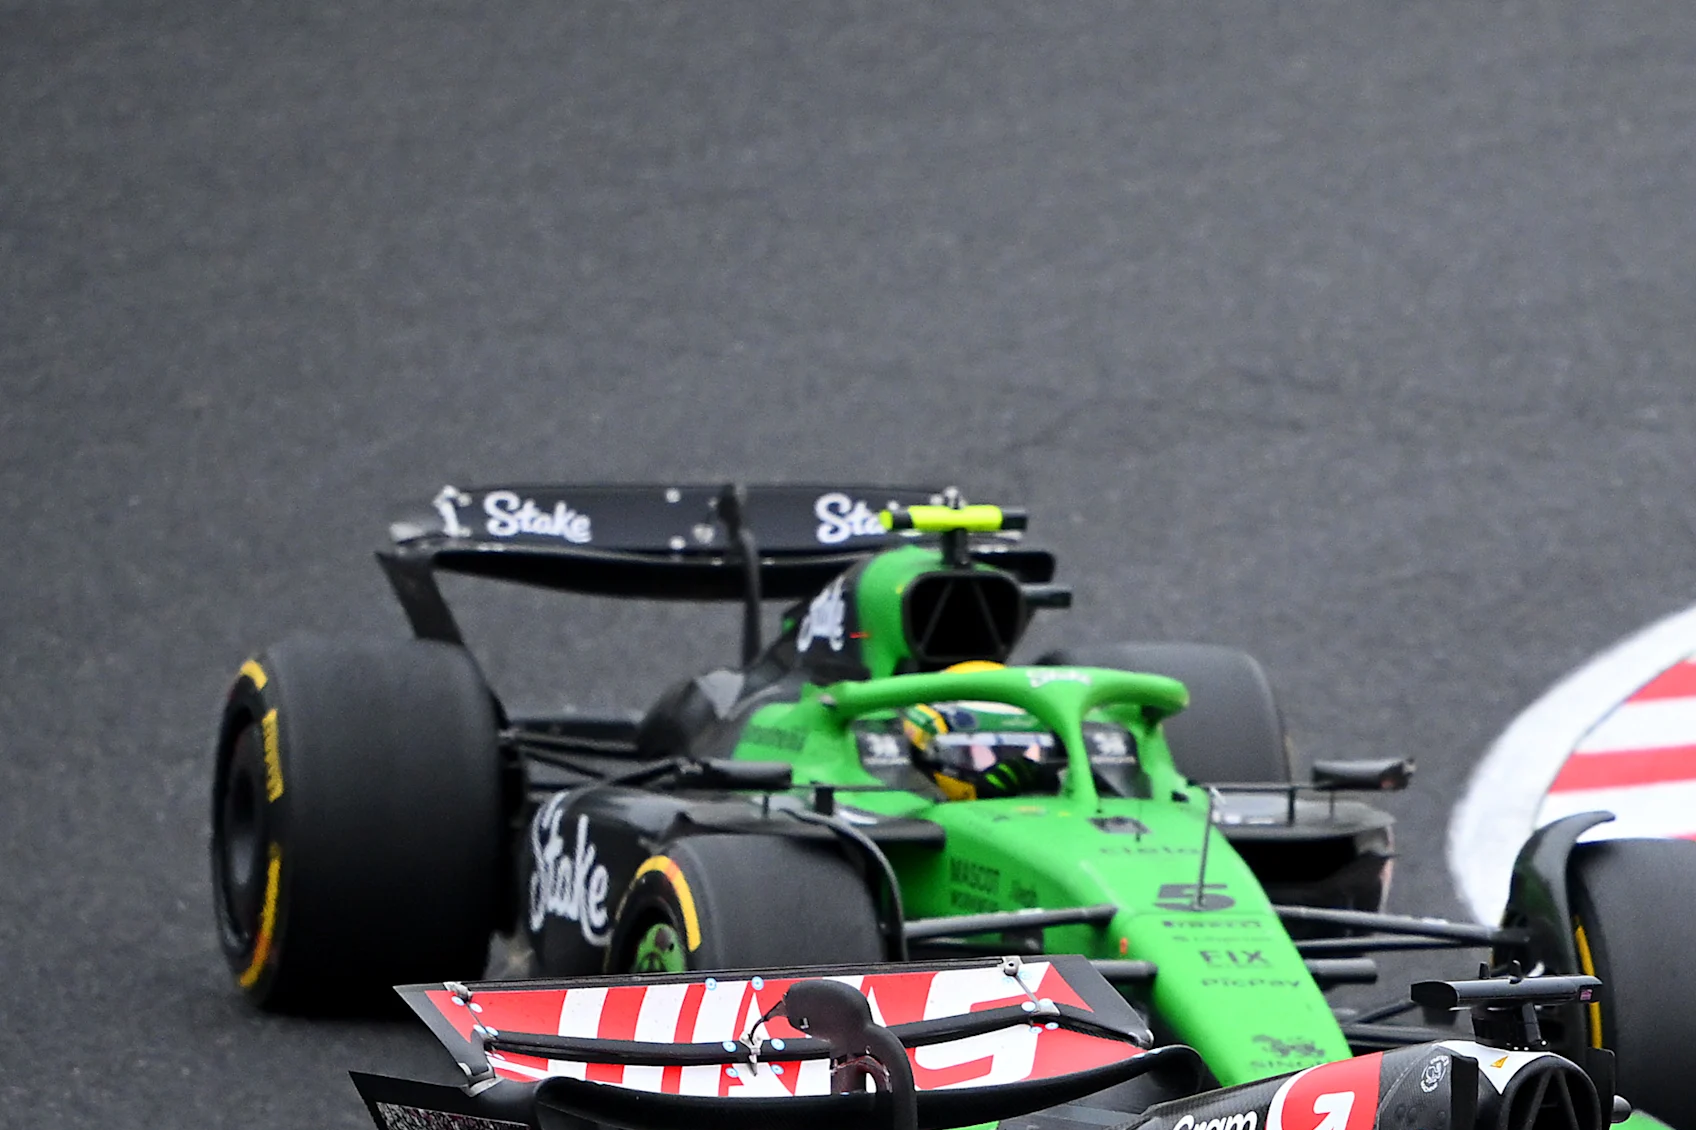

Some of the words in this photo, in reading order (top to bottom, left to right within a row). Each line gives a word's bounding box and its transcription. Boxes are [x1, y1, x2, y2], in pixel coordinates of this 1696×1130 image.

[483, 490, 592, 543] Stake
[815, 492, 892, 543] Sta
[530, 790, 612, 946] Stake
[1153, 883, 1236, 912] 5
